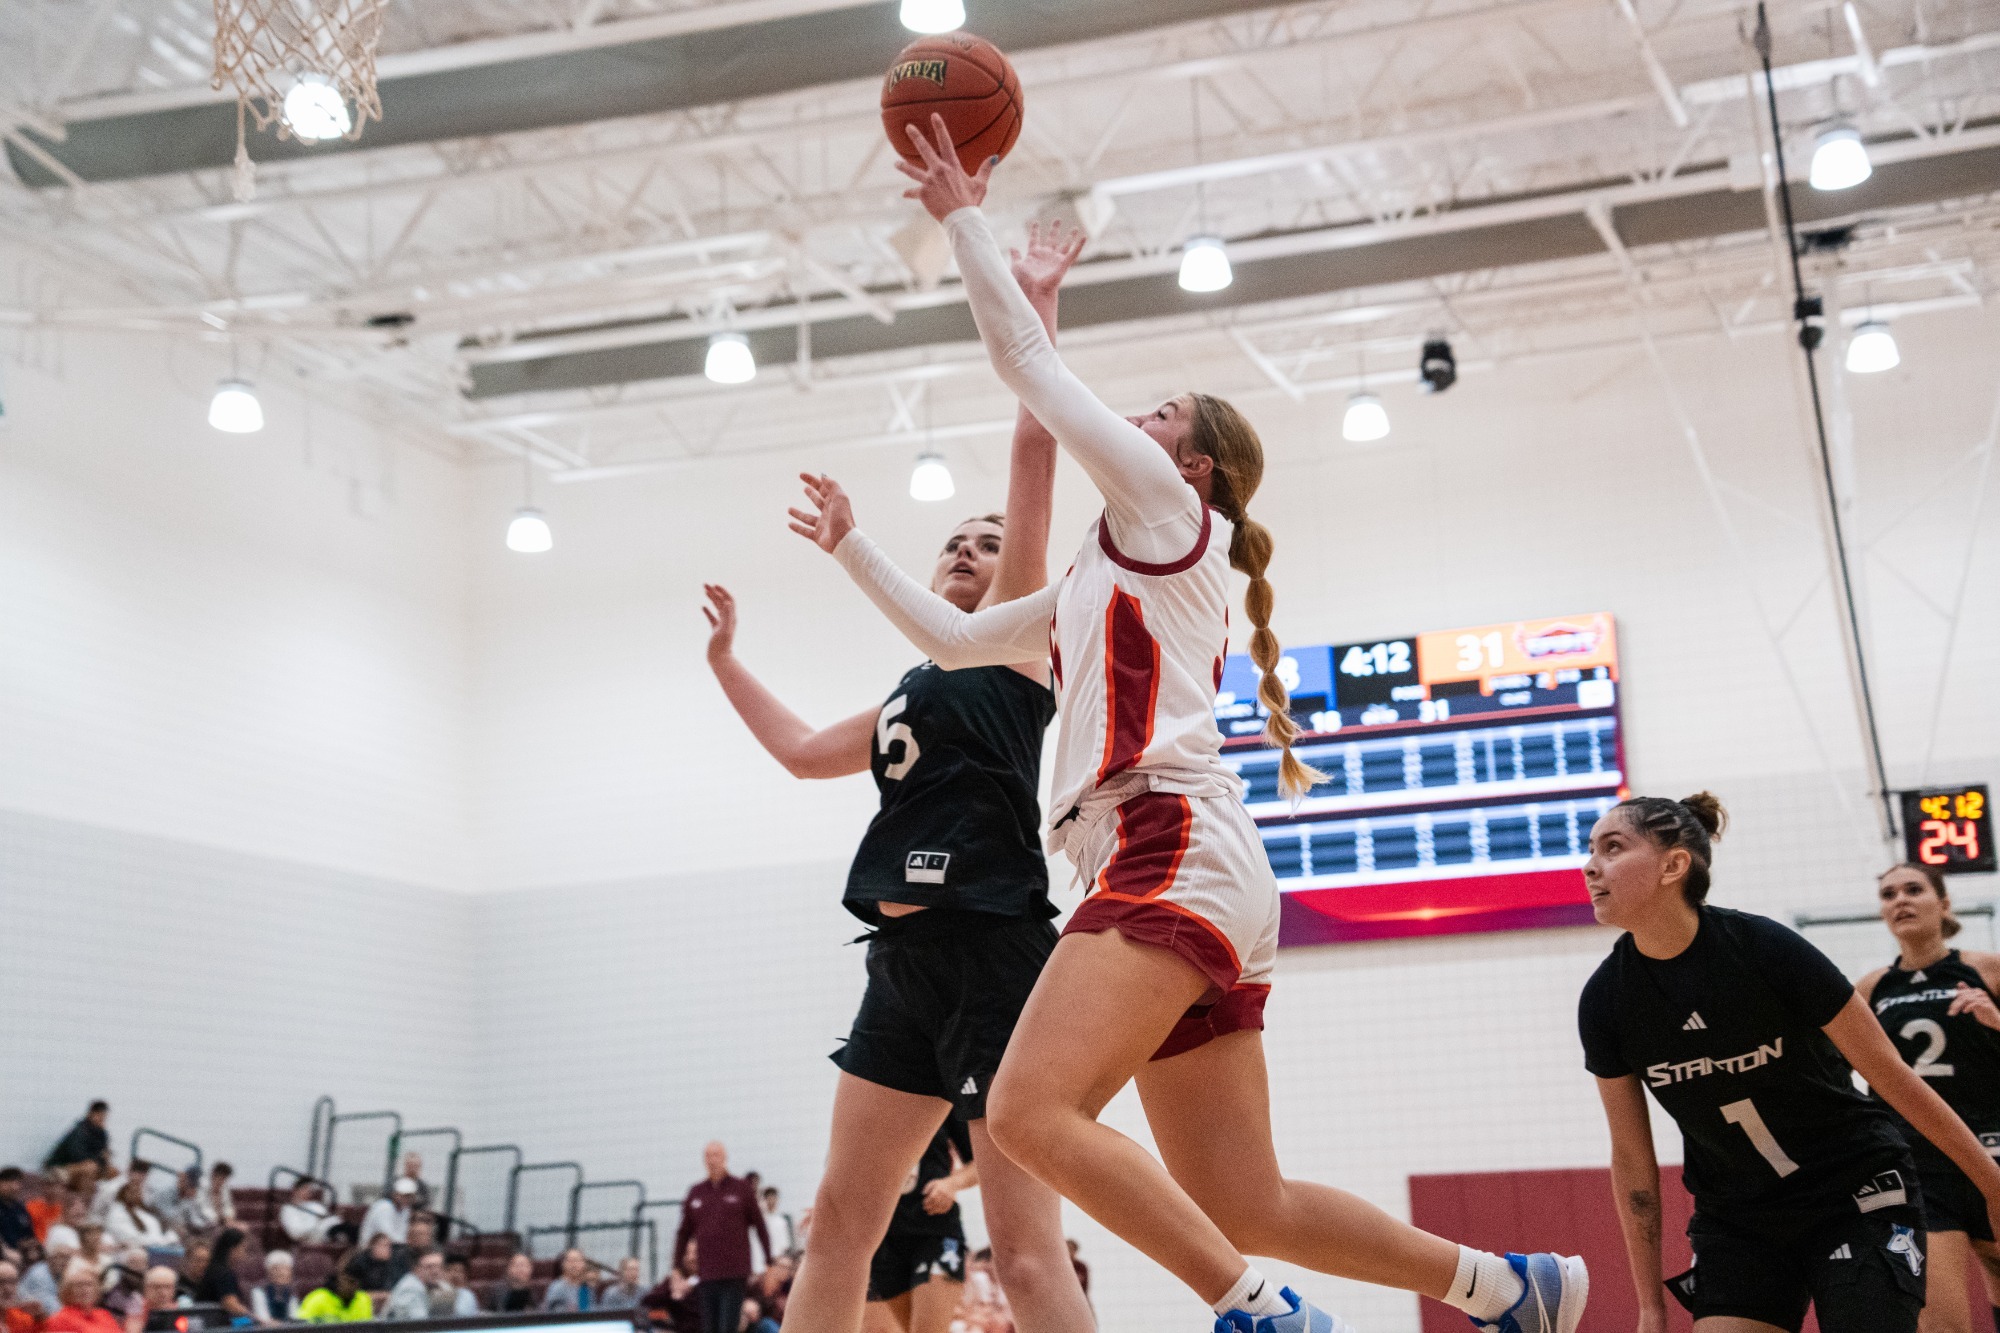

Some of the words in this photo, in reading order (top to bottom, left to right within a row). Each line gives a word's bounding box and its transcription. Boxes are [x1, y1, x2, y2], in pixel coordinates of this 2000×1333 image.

[889, 60, 948, 93] NAIA
[1340, 641, 1411, 677] 4:12
[1457, 632, 1504, 671] 31
[877, 694, 921, 781] 5
[1920, 820, 1979, 864] 24
[1646, 1036, 1783, 1088] STANTON
[1900, 1018, 1954, 1076] 2
[1719, 1098, 1800, 1178] 1
